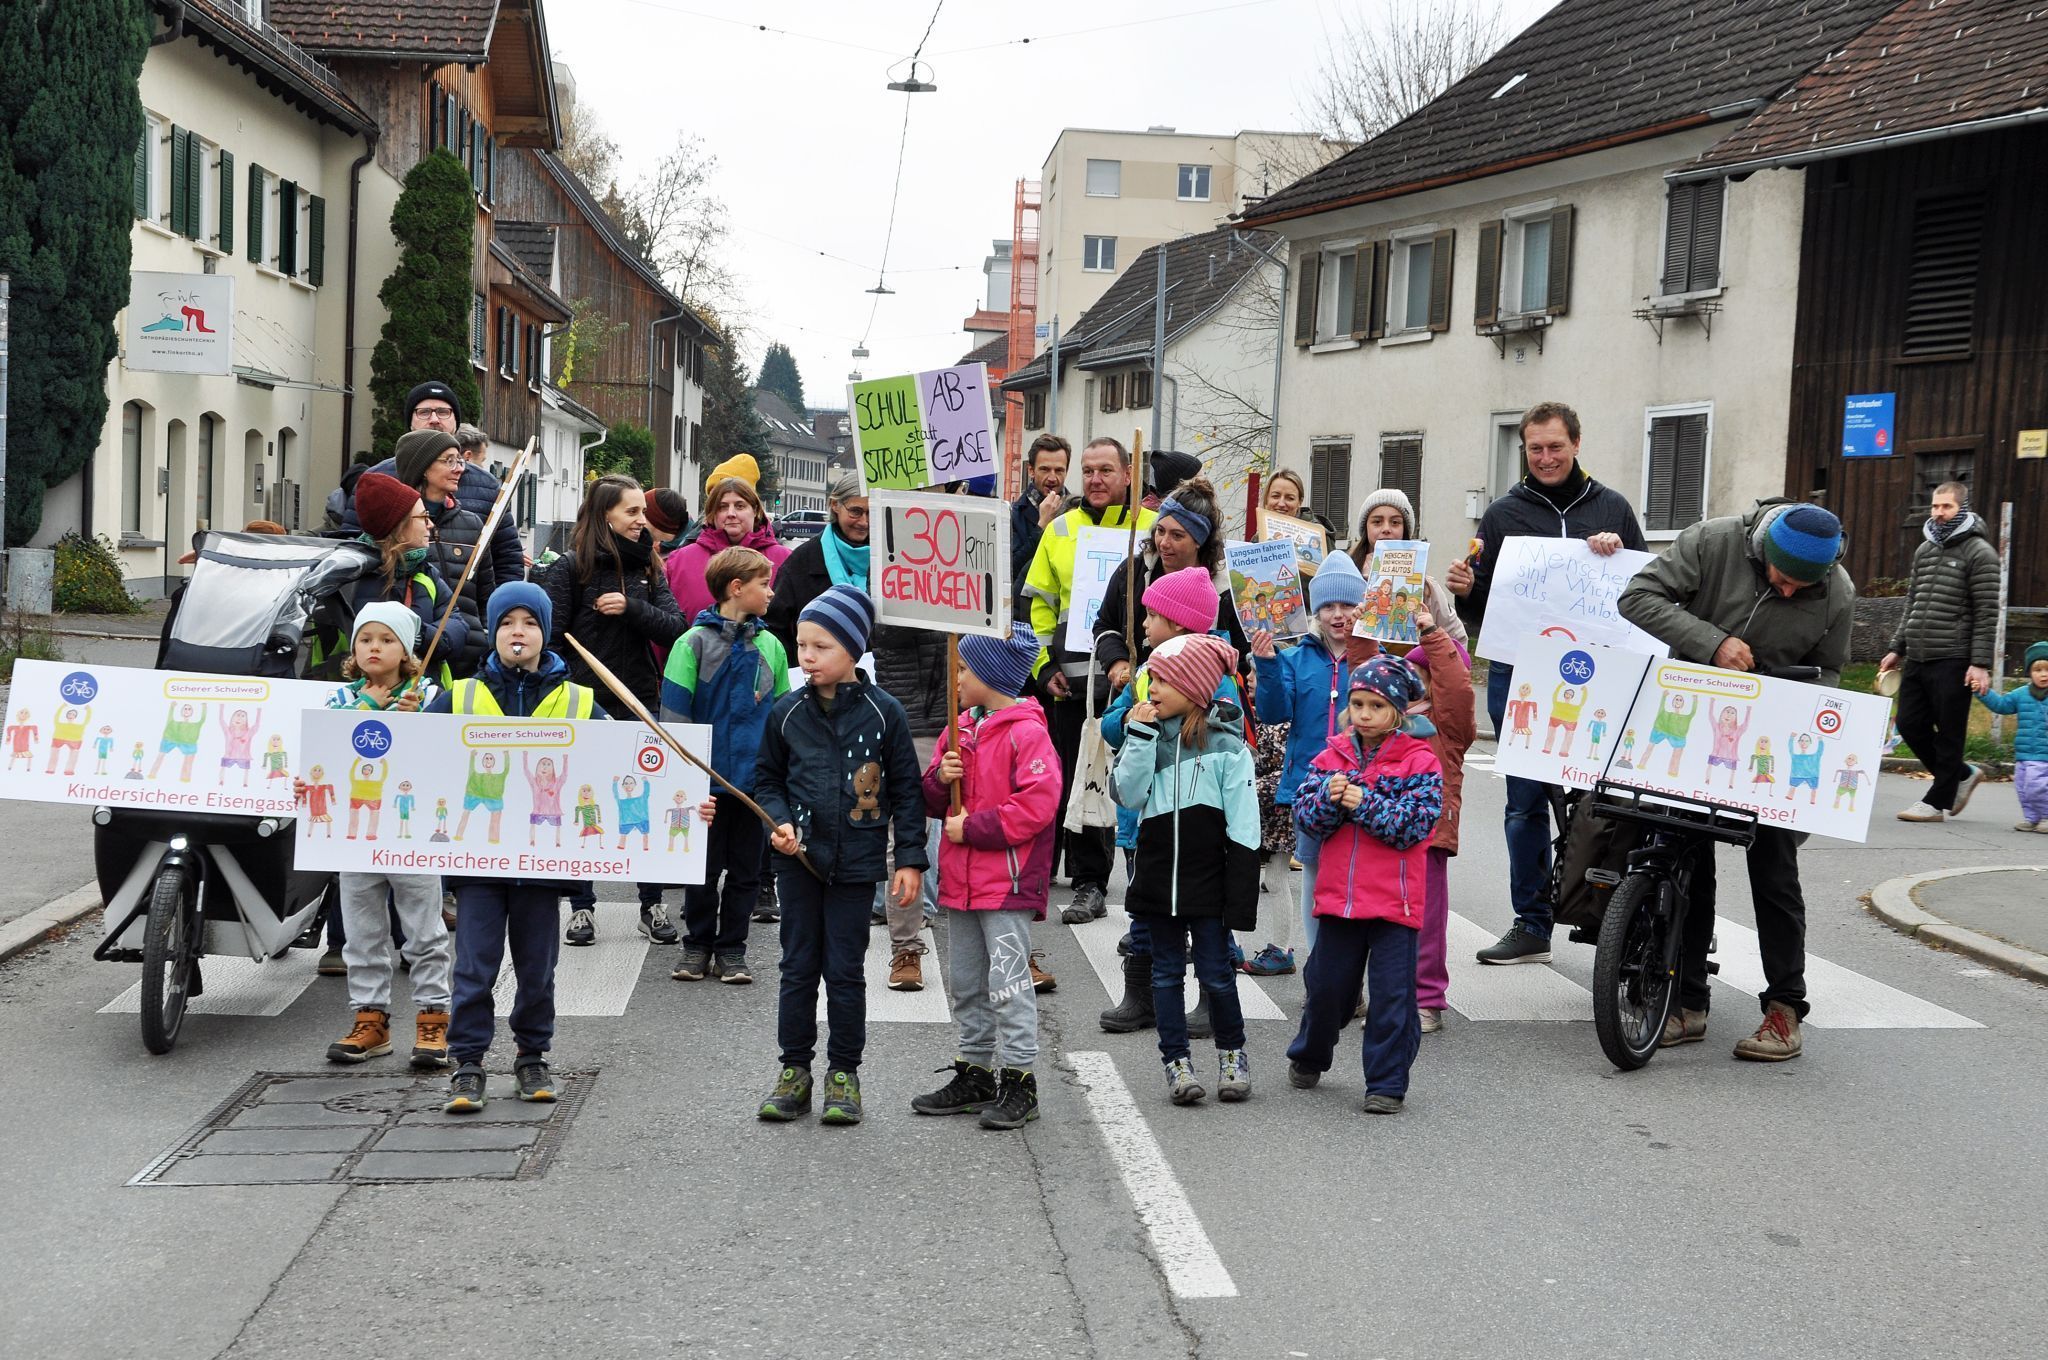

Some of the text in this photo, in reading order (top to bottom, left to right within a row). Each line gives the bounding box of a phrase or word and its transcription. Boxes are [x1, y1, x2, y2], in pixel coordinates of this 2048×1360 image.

[929, 371, 976, 416] AB-
[855, 390, 918, 431] SCHUL-
[905, 423, 938, 443] statt
[931, 430, 992, 472] GASE
[900, 507, 961, 567] 30
[1230, 547, 1261, 558] Langsam
[1232, 551, 1291, 567] Kinder lachen!
[882, 564, 981, 612] GENÜGEN
[1516, 565, 1621, 601] sind Wicht
[171, 685, 263, 694] Sicherer Schulweg!
[1664, 672, 1754, 692] Sicherer Schulweg!
[1824, 699, 1844, 711] ZONE
[1821, 716, 1836, 727] 30
[469, 730, 568, 739] Sicherer Schulweg!
[644, 735, 664, 746] ZONE
[643, 753, 659, 765] 30
[67, 783, 199, 806] Kindersichere
[371, 849, 632, 877] Kindersichere Eisengasse!
[989, 979, 1030, 1003] ONVE
